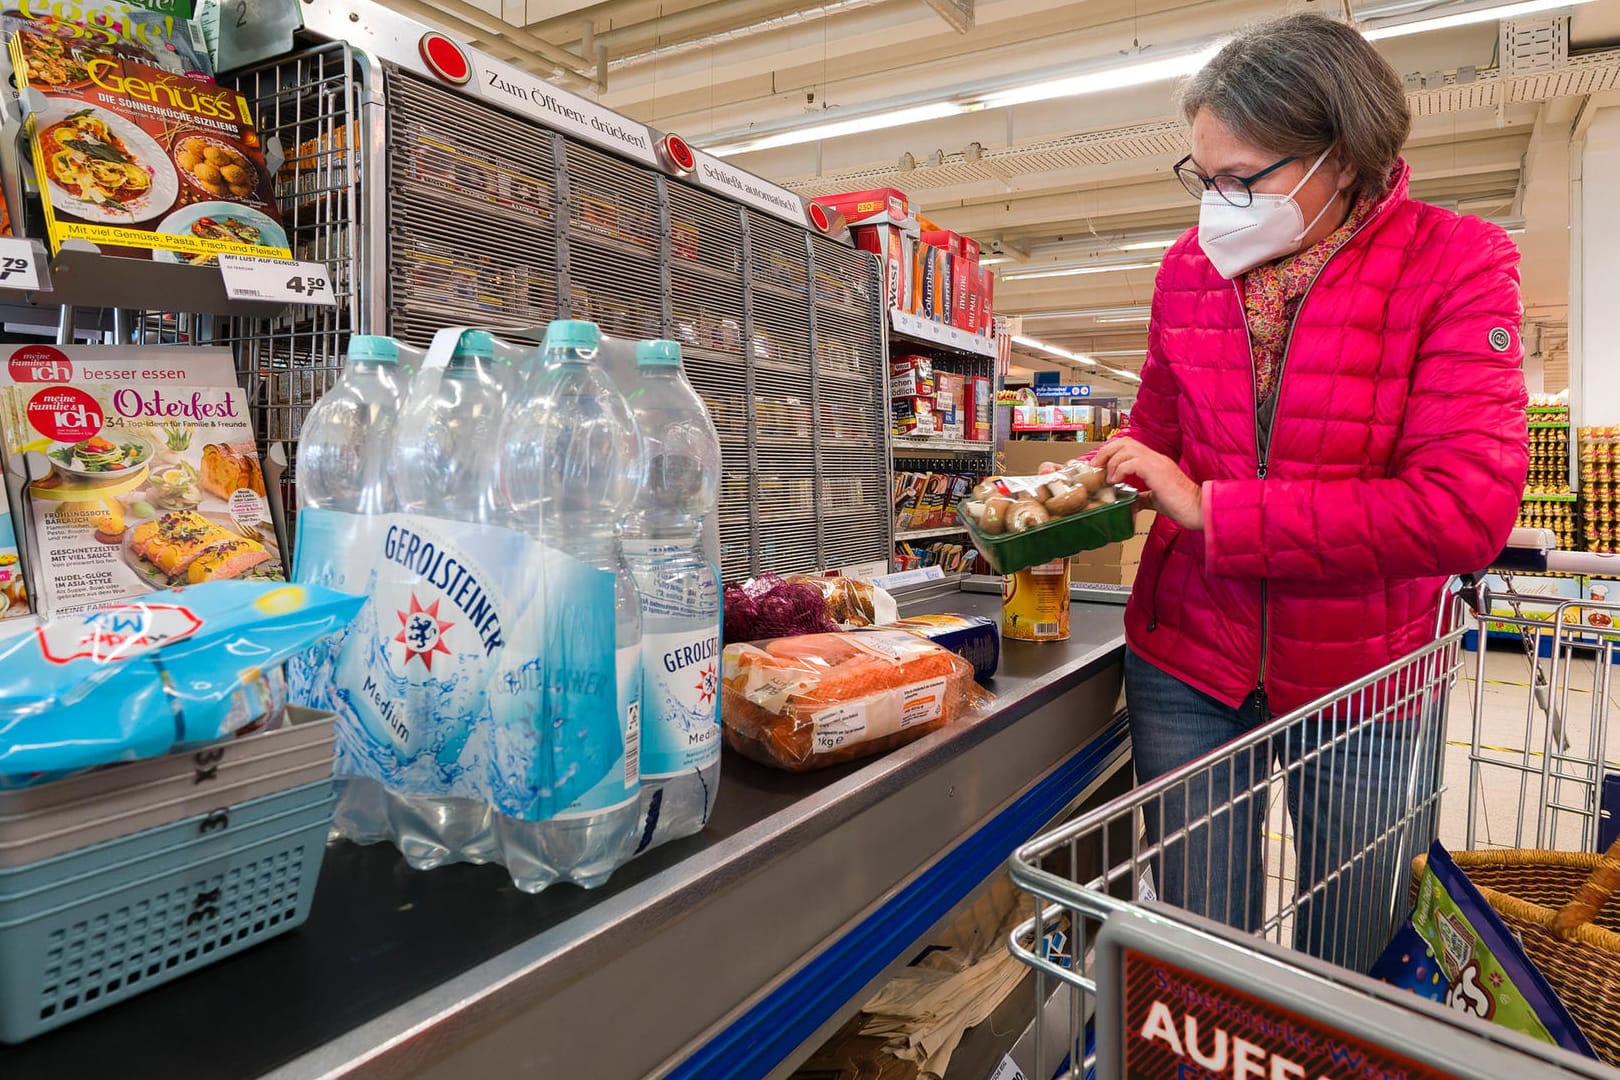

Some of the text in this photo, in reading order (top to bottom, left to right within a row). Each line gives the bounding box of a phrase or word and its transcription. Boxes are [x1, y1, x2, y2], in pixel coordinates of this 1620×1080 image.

[87, 59, 236, 120] Genuss
[97, 93, 115, 105] DIE
[119, 97, 192, 122] SONNENKÜCHE
[194, 117, 238, 133] SIZILIENS
[486, 70, 647, 150] Zum Öffnen: drücken!
[703, 164, 798, 213] Schließt automatisch!
[858, 203, 872, 211] 250
[68, 225, 88, 235] Mit
[91, 226, 110, 236] viel
[113, 229, 163, 243] Gemüse,
[166, 235, 198, 248] Pasta,
[201, 239, 227, 251] Fisch
[230, 243, 248, 253] und
[250, 245, 283, 257] Fleisch
[889, 264, 898, 308] West
[925, 258, 935, 320] Columbus
[11, 359, 43, 367] Familie
[24, 352, 50, 360] meine
[31, 361, 70, 380] ich
[83, 367, 186, 380] besser essen
[29, 401, 70, 411] Familie
[44, 394, 76, 402] meine
[113, 388, 239, 421] Osterfest
[54, 404, 101, 428] ich
[105, 416, 124, 428] 34
[127, 420, 168, 428] Top-Ideen
[170, 420, 181, 428] für
[183, 420, 208, 428] Familie
[218, 420, 247, 428] Freunde
[50, 545, 120, 556] GESCHNETZELTES
[54, 571, 113, 582] NUDEL-GLÜCK
[67, 578, 112, 587] ASIA-STYLE
[385, 525, 504, 657] GEROLSTEINER
[363, 676, 410, 743] Medium
[818, 737, 834, 748] 1kg
[1141, 1000, 1332, 1080] AUFF
